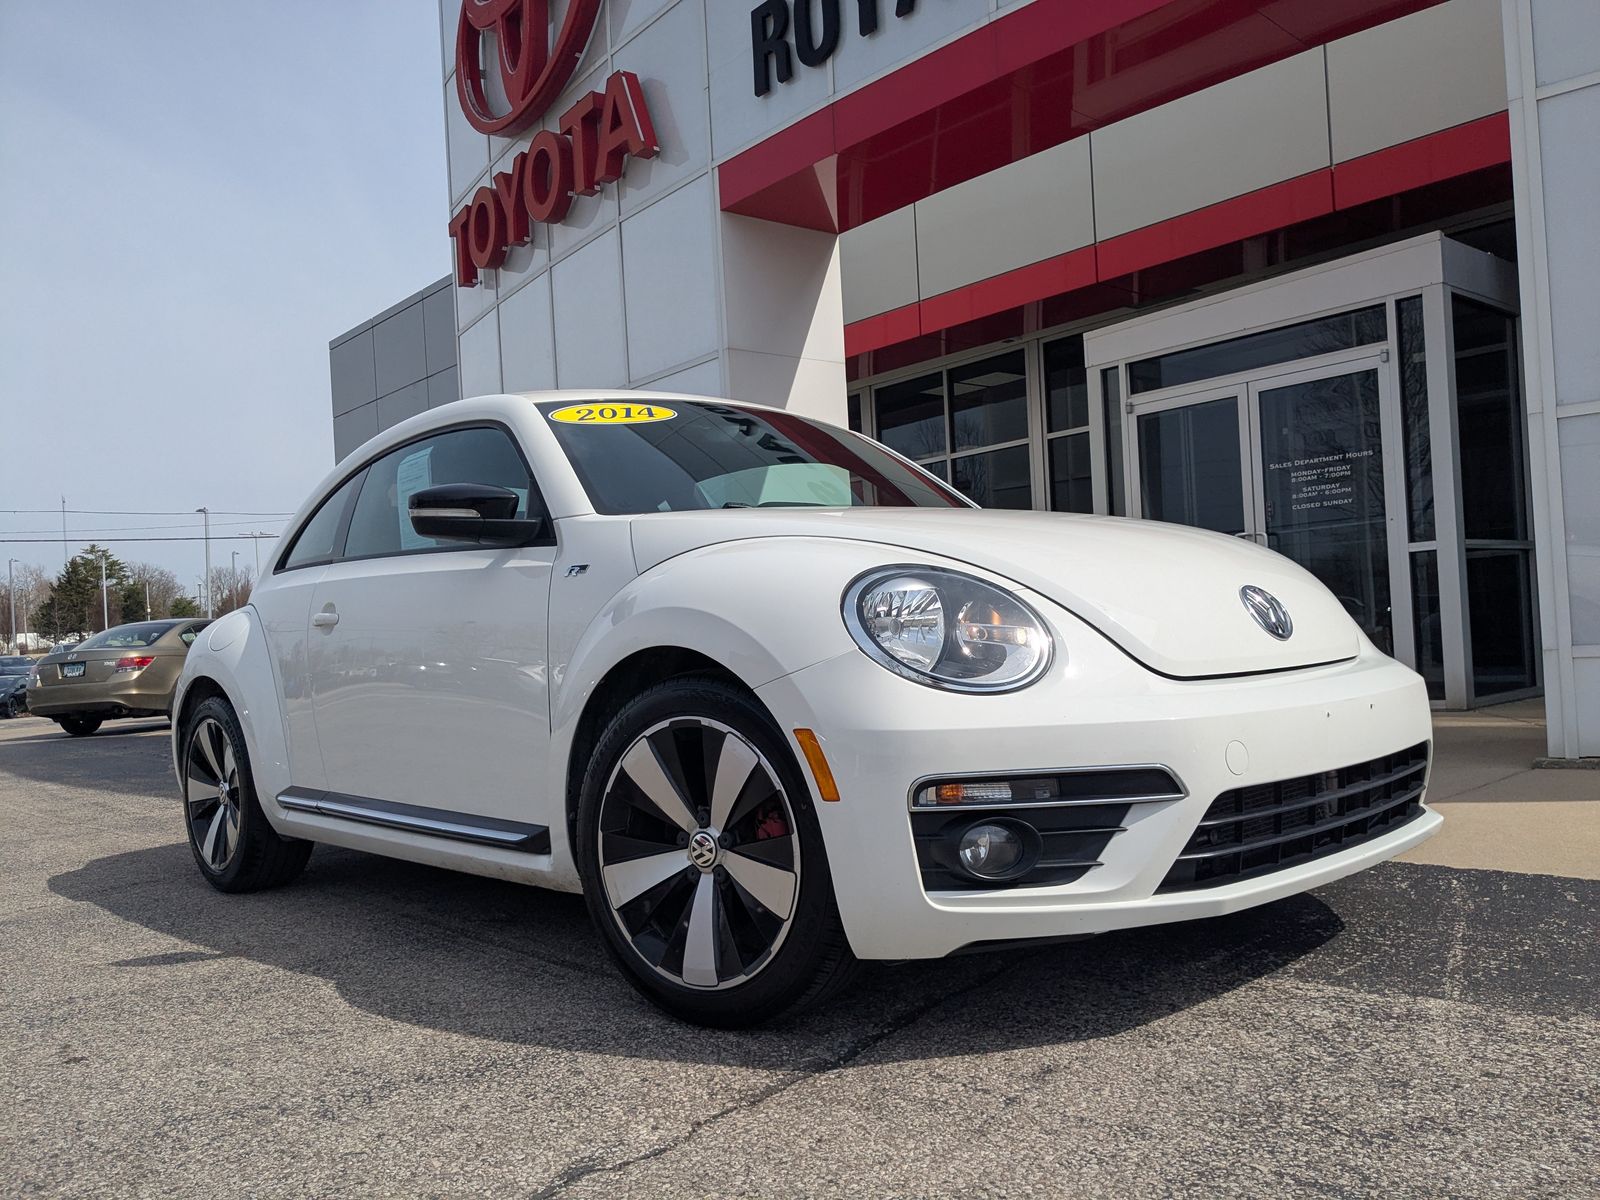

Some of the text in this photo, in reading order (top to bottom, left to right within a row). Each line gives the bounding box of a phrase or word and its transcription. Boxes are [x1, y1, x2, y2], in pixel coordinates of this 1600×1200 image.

[448, 69, 660, 288] TOYOTA
[576, 406, 657, 421] 2014
[1294, 454, 1344, 466] DEPARTMENT
[1345, 450, 1374, 459] HOURS
[1302, 483, 1340, 492] SATURDAY
[1292, 498, 1353, 510] CLOSED SUNDAY
